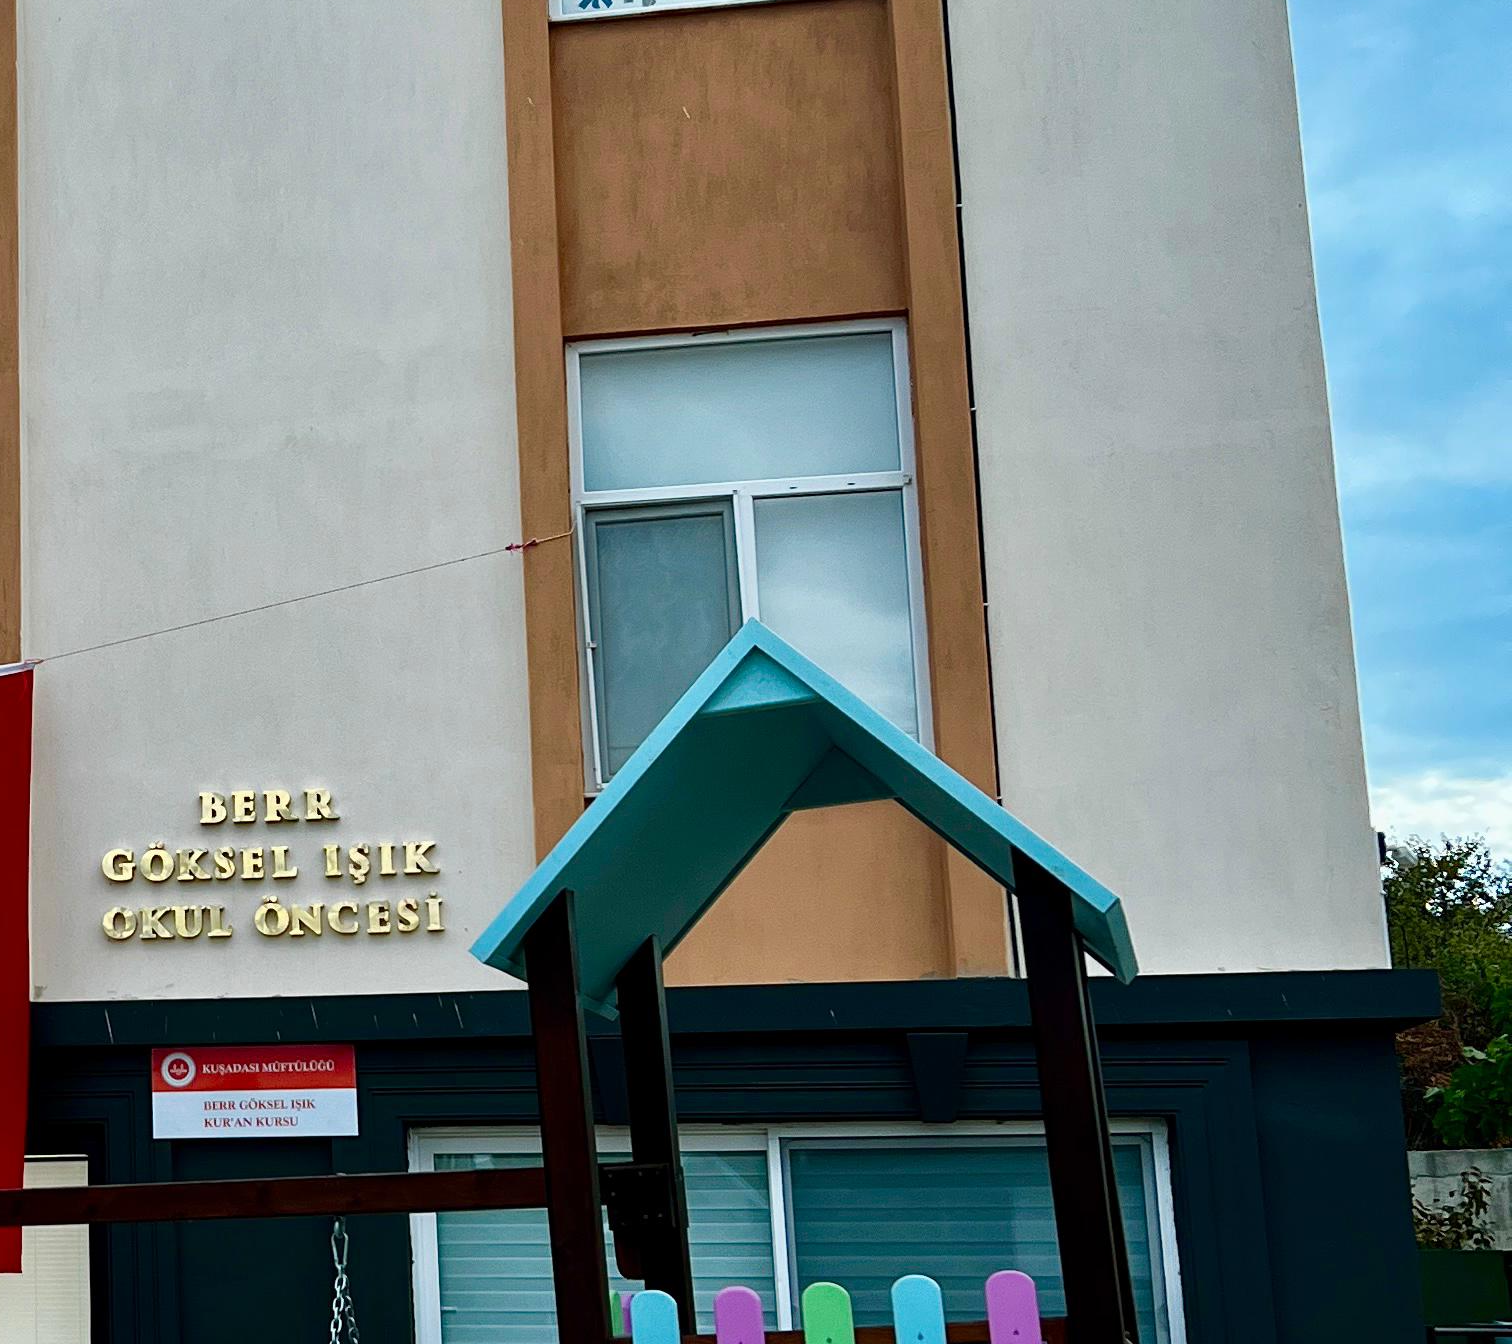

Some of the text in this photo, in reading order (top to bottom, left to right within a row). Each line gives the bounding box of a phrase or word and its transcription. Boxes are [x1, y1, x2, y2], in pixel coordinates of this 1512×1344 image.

[199, 788, 340, 825] BERR
[101, 840, 441, 885] GÖKSEL IŞIK
[102, 892, 446, 940] OKUL ÖNCESİ
[202, 1060, 335, 1075] KUŞADASI MÜFTÜLÜĞÜ
[203, 1098, 316, 1112] BERR GÖKSEL IŞIK
[204, 1116, 299, 1128] KUR'AN KURSU
